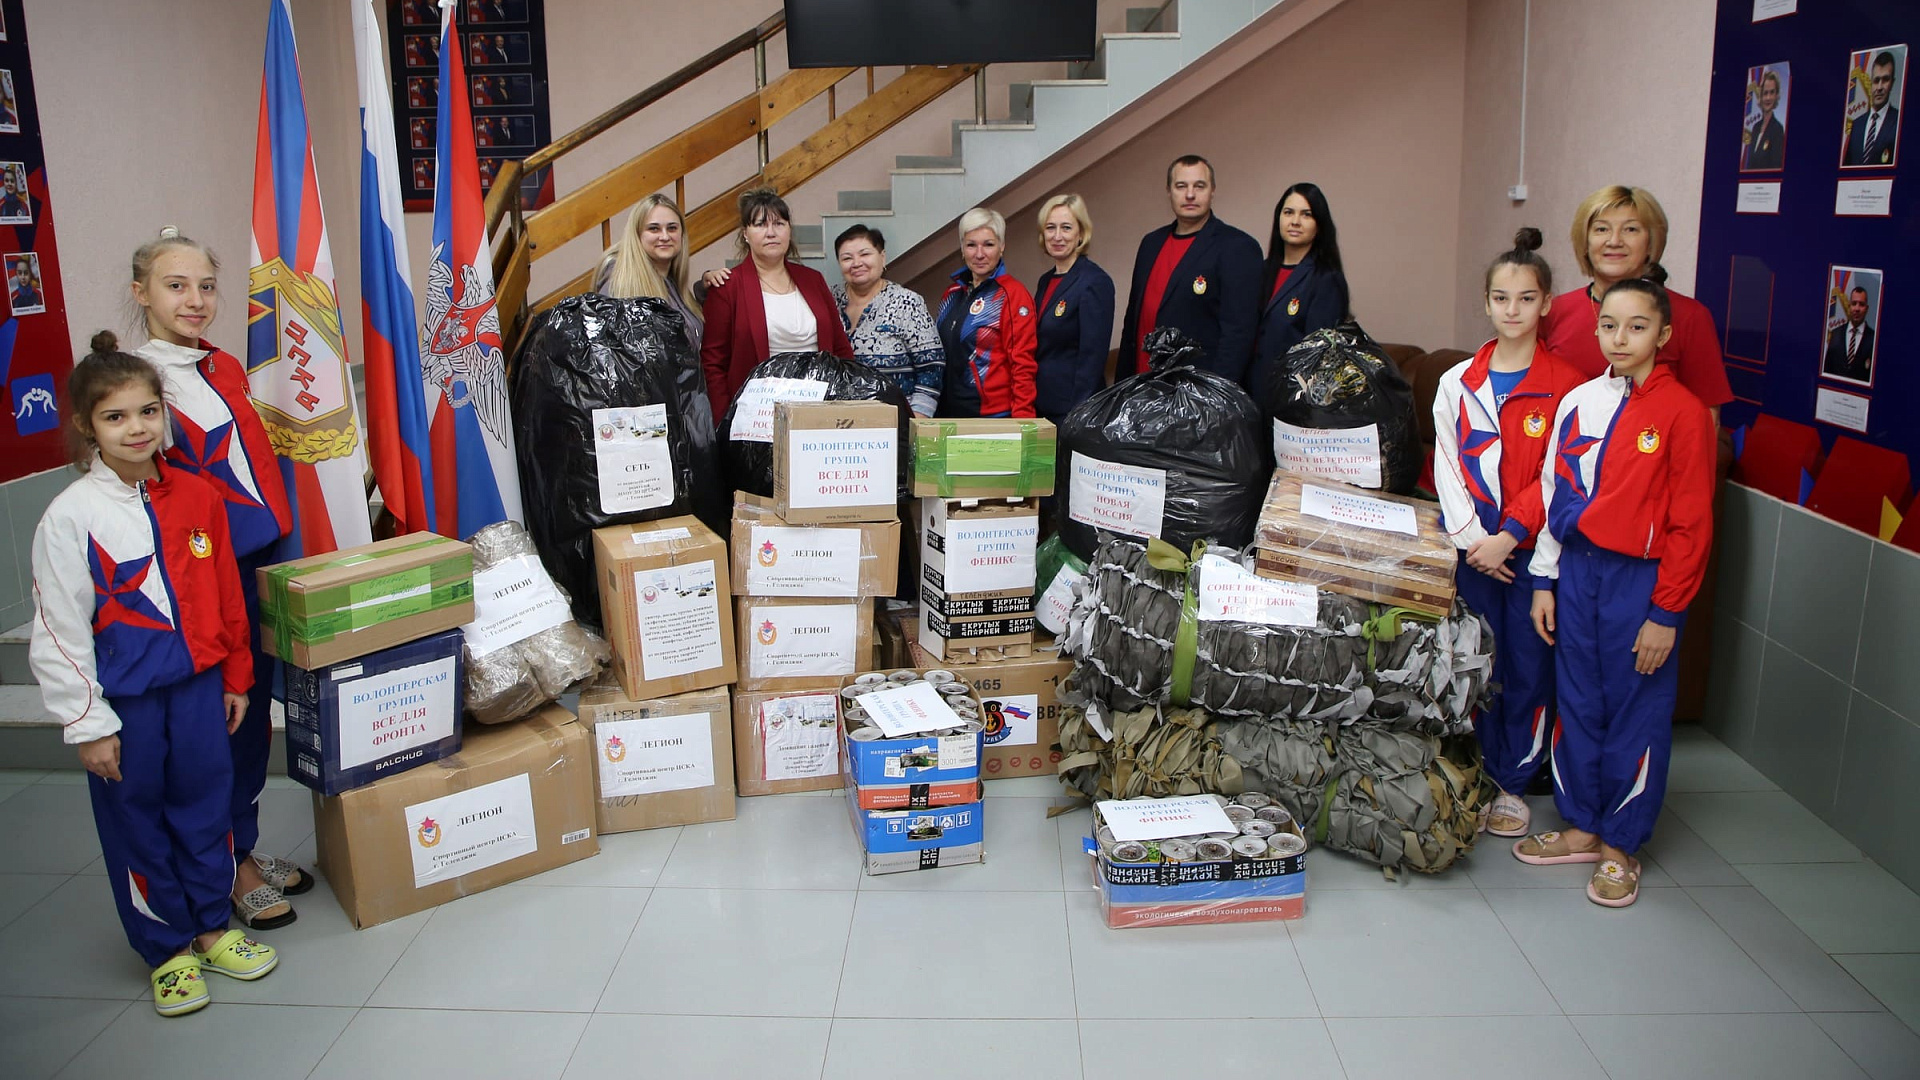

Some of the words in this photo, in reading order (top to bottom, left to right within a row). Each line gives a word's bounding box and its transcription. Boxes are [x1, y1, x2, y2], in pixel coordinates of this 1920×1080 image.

[1282, 434, 1370, 444] ВОЛОНТЕРСКАЯ
[802, 441, 889, 451] ВОЛОНТЕРСКАЯ
[1304, 446, 1348, 454] ГРУППА
[824, 456, 868, 465] ГРУППА
[1280, 453, 1309, 462] СОВЕТ
[1314, 456, 1372, 464] ВЕТЕРАНОВ
[625, 463, 650, 472] СЕТЬ
[818, 471, 841, 480] ВСЕ
[844, 470, 869, 481] ДЛЯ
[1078, 466, 1158, 487] ВОЛОНТЕРСКАЯ
[818, 485, 868, 494] ФРОНТА
[1097, 483, 1136, 497] ГРУППА
[1096, 495, 1130, 509] НОВАЯ
[1093, 507, 1132, 521] РОССИЯ
[957, 528, 1036, 540] ВОЛОНТЕРСКАЯ
[977, 543, 1016, 552] ГРУППА
[791, 550, 832, 558] ЛЕГИОН
[970, 555, 1017, 566] ФЕНИКС
[493, 578, 532, 600] ЛЕГИОН
[1207, 584, 1241, 592] СОВЕТ
[968, 621, 1000, 629] КРУТЫХ
[790, 627, 830, 635] ЛЕГИОН
[353, 671, 448, 705] ВОЛОНТЕРСКАЯ
[974, 679, 1001, 690] 465
[378, 694, 425, 713] ГРУППА
[372, 717, 397, 732] ВСЕ
[400, 707, 427, 725] ДЛЯ
[372, 723, 426, 746] ФРОНТА
[640, 738, 683, 749] ЛЕГИОН
[375, 750, 423, 771] BALCHUG
[618, 767, 656, 776] Спортивный
[676, 763, 695, 771] ЦСКА
[1114, 800, 1209, 811] ВОЛОНТЕРСКАЯ
[457, 806, 503, 827] ЛЕГИОН
[432, 843, 476, 861] Спортивный
[477, 838, 496, 850] центр
[497, 831, 517, 843] ЦСКА
[441, 852, 477, 867] Геленджик
[1196, 906, 1282, 917] воздухонагреватель
